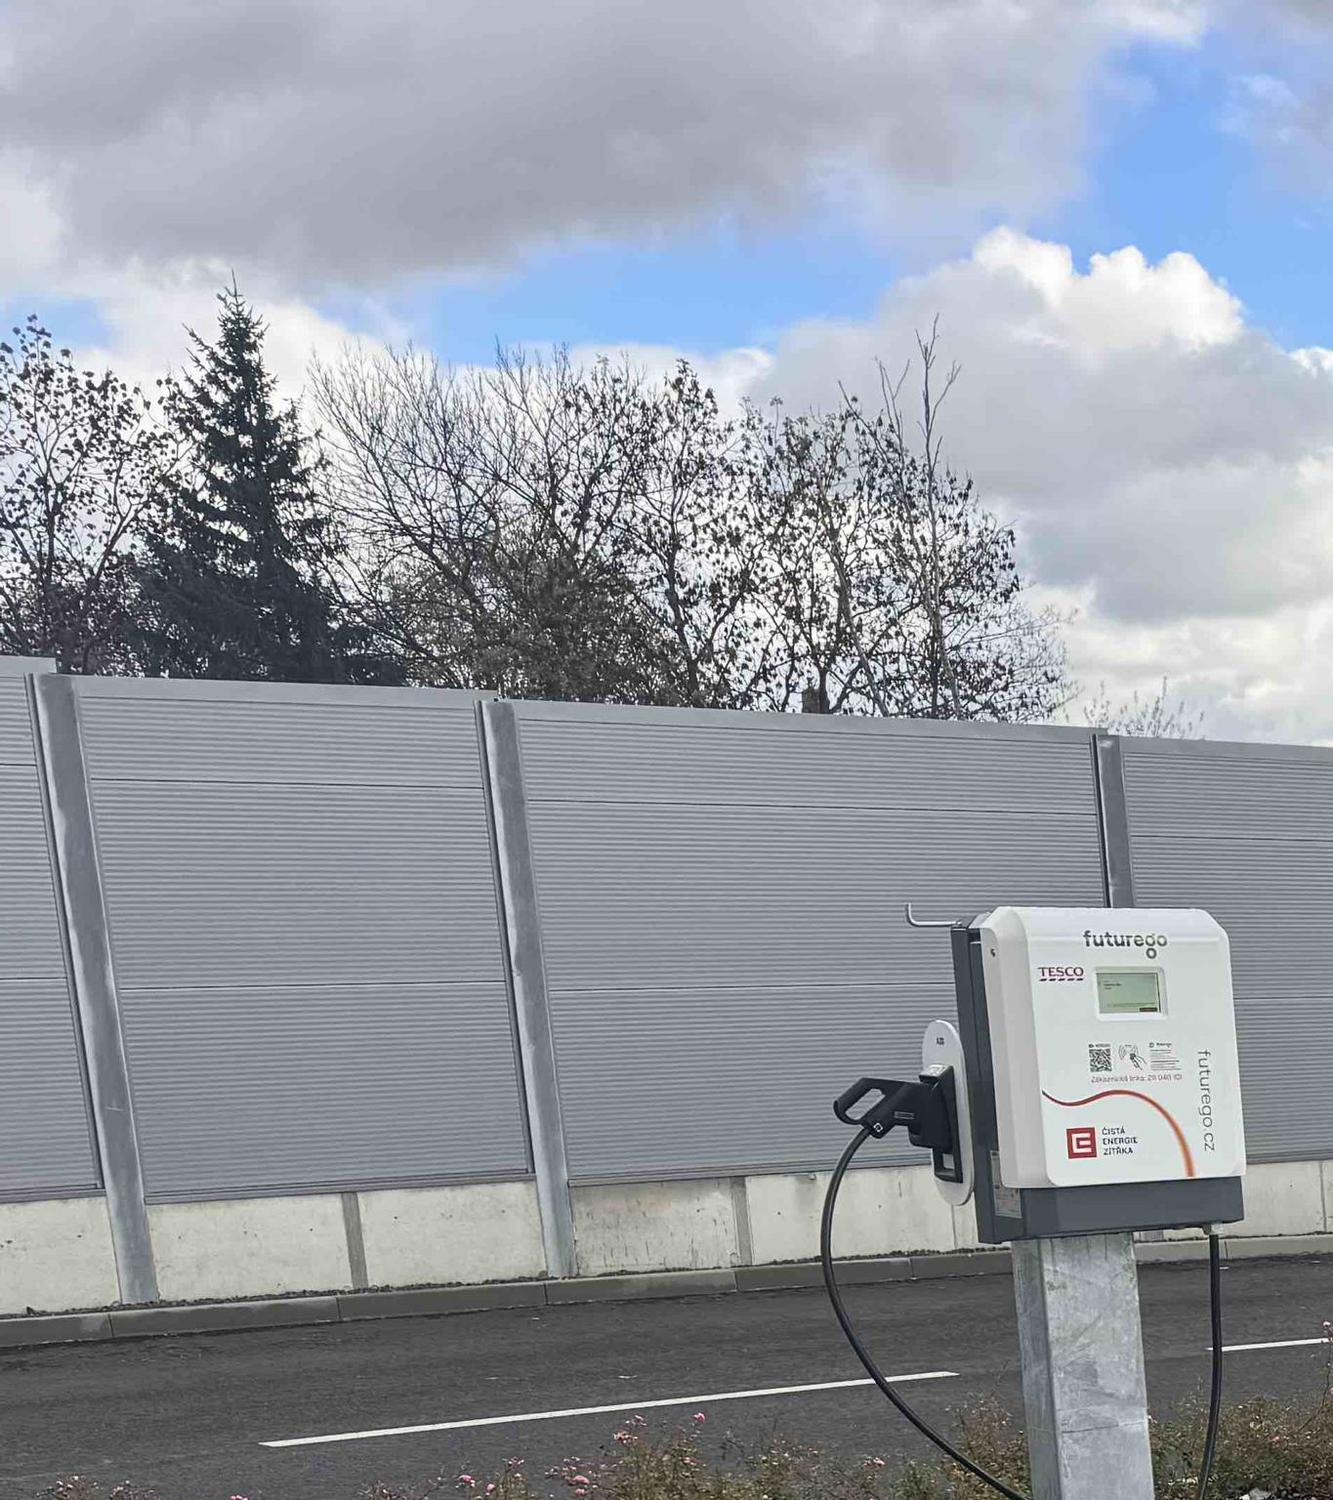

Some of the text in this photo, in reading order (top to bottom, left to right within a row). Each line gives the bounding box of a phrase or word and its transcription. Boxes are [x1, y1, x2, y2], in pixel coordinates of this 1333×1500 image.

[1083, 930, 1168, 959] futurego
[1037, 966, 1084, 978] TESCO
[1197, 1048, 1215, 1152] futurego.cz
[1102, 1136, 1138, 1146] ENERGIE
